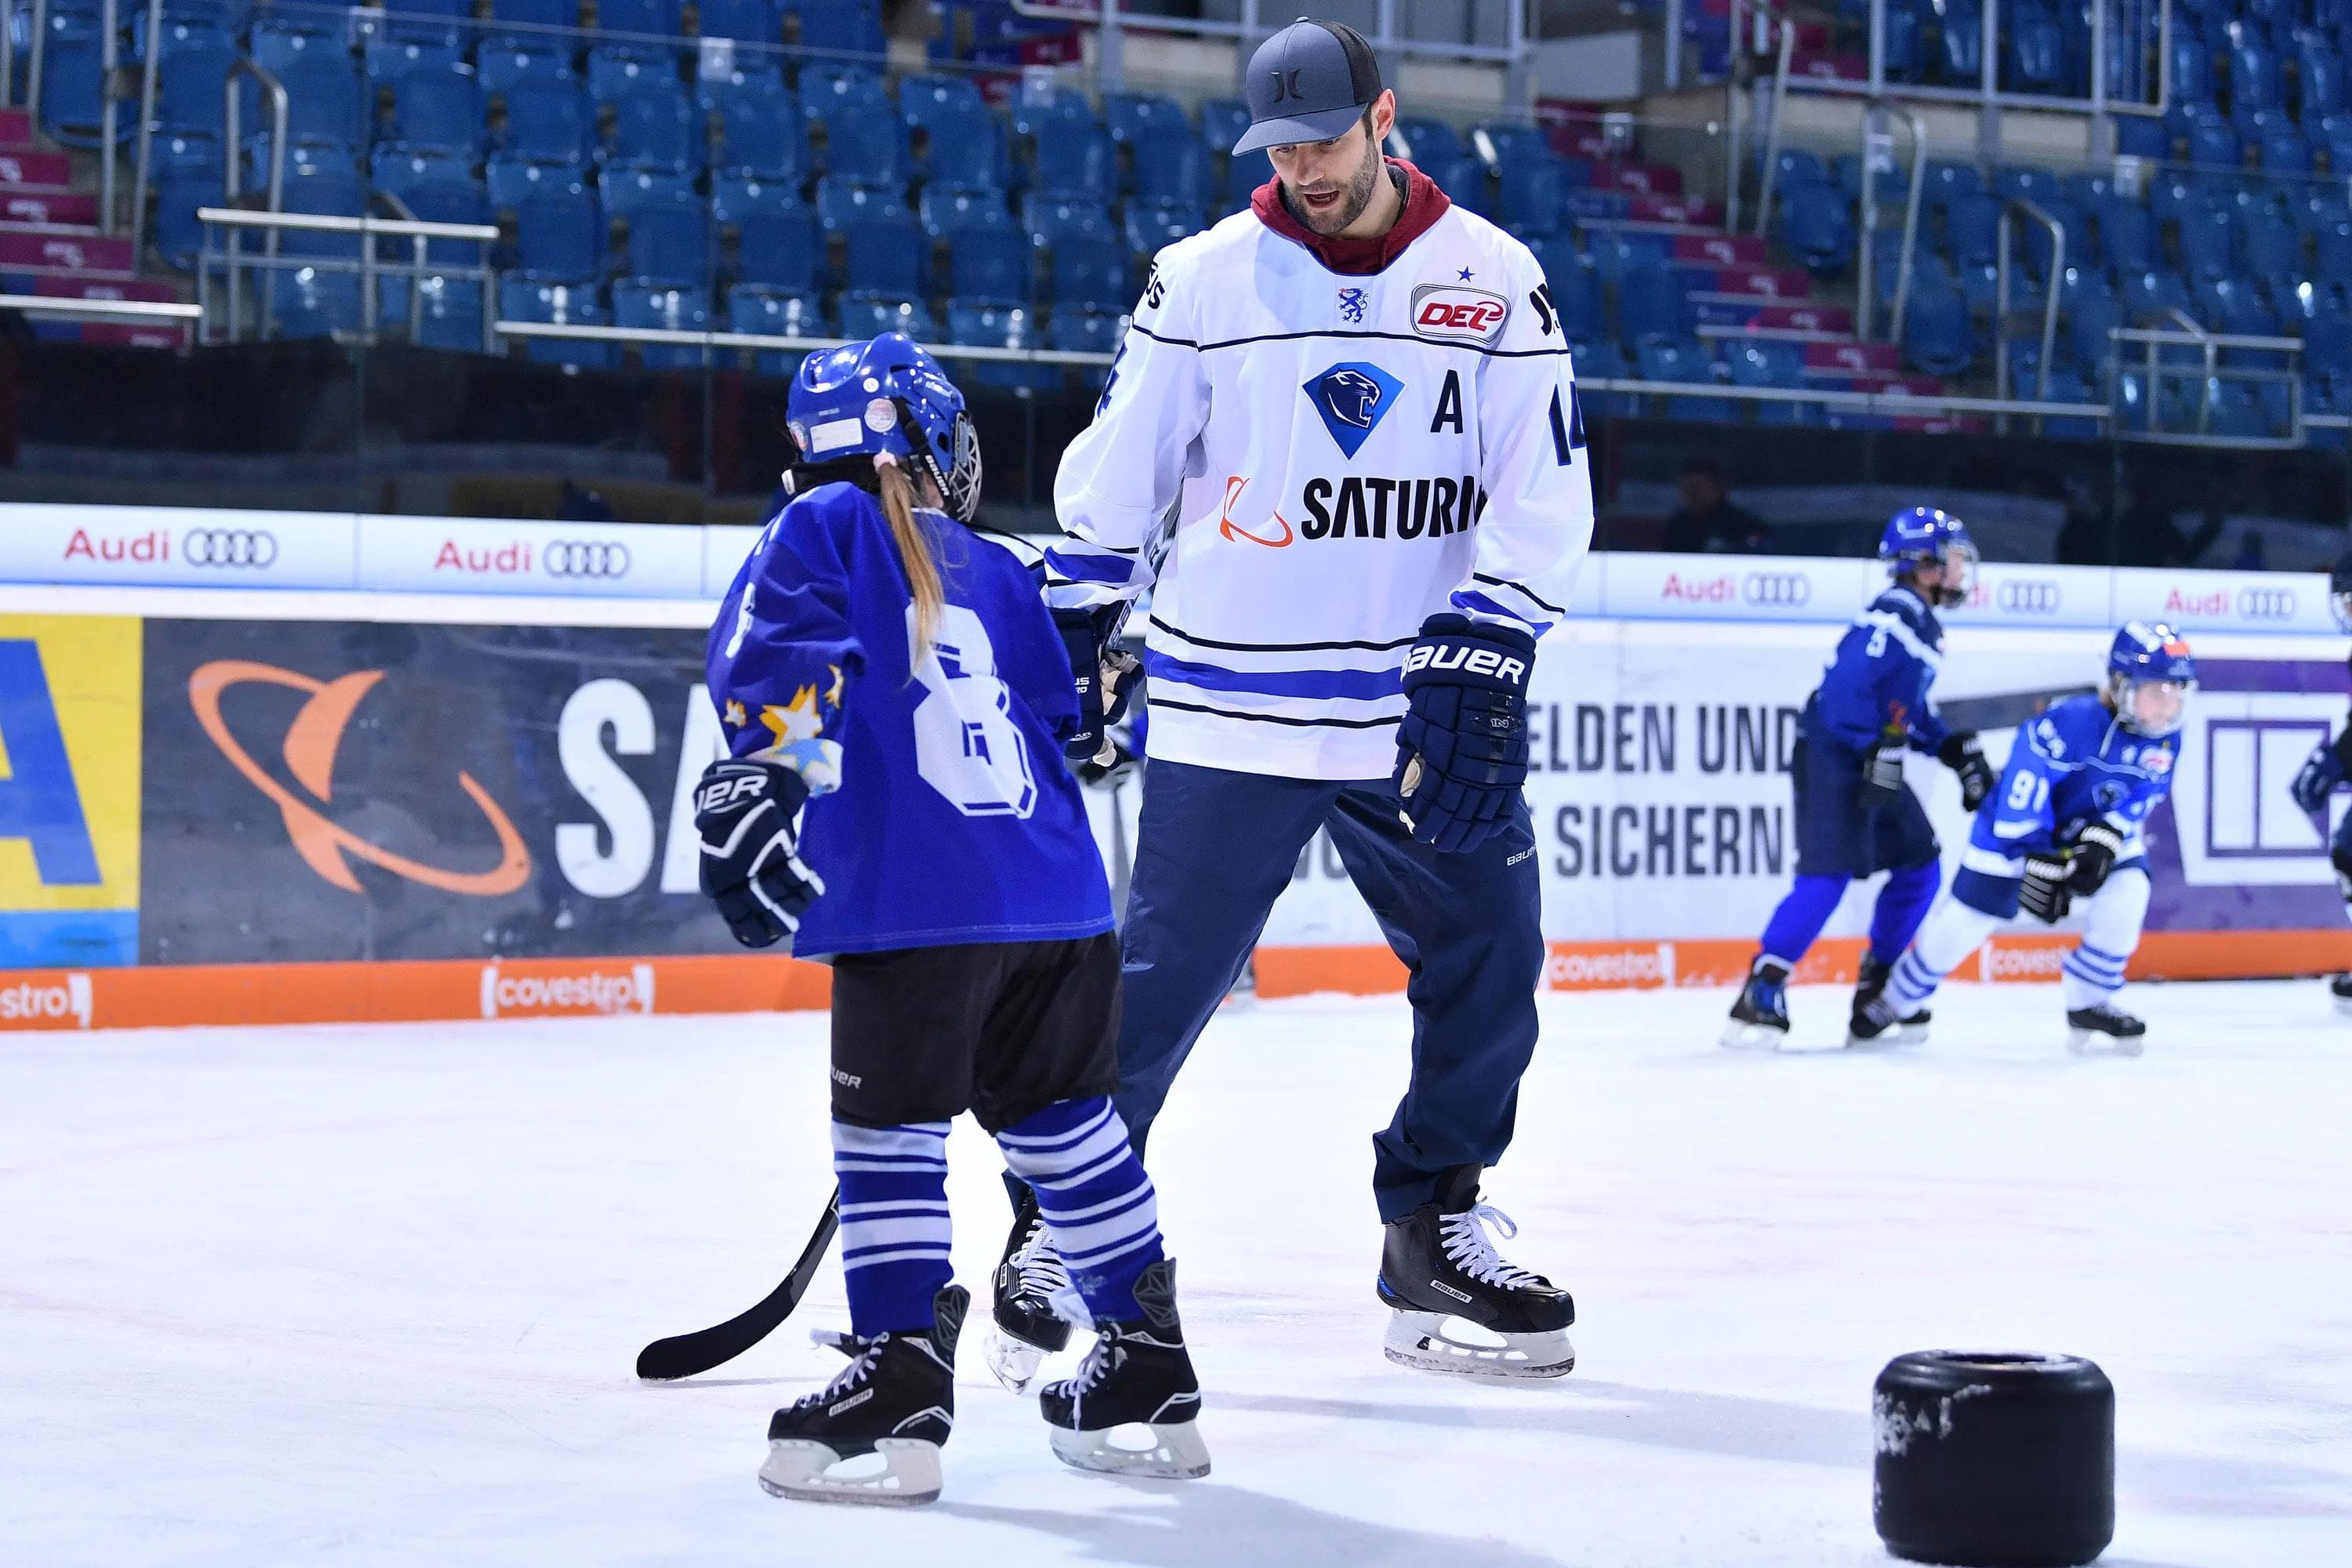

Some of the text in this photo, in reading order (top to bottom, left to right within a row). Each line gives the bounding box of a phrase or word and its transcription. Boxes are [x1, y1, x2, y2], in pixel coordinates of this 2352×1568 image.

[1430, 369, 1463, 434] A
[64, 528, 169, 562] Audi
[435, 540, 532, 572] Audi
[1661, 573, 1736, 602] Audi
[2165, 587, 2230, 616] Audi
[905, 602, 1038, 819] 8
[2008, 769, 2049, 812] 91
[1556, 806, 1782, 877] SICHERN
[1434, 1282, 1469, 1301] BAUER
